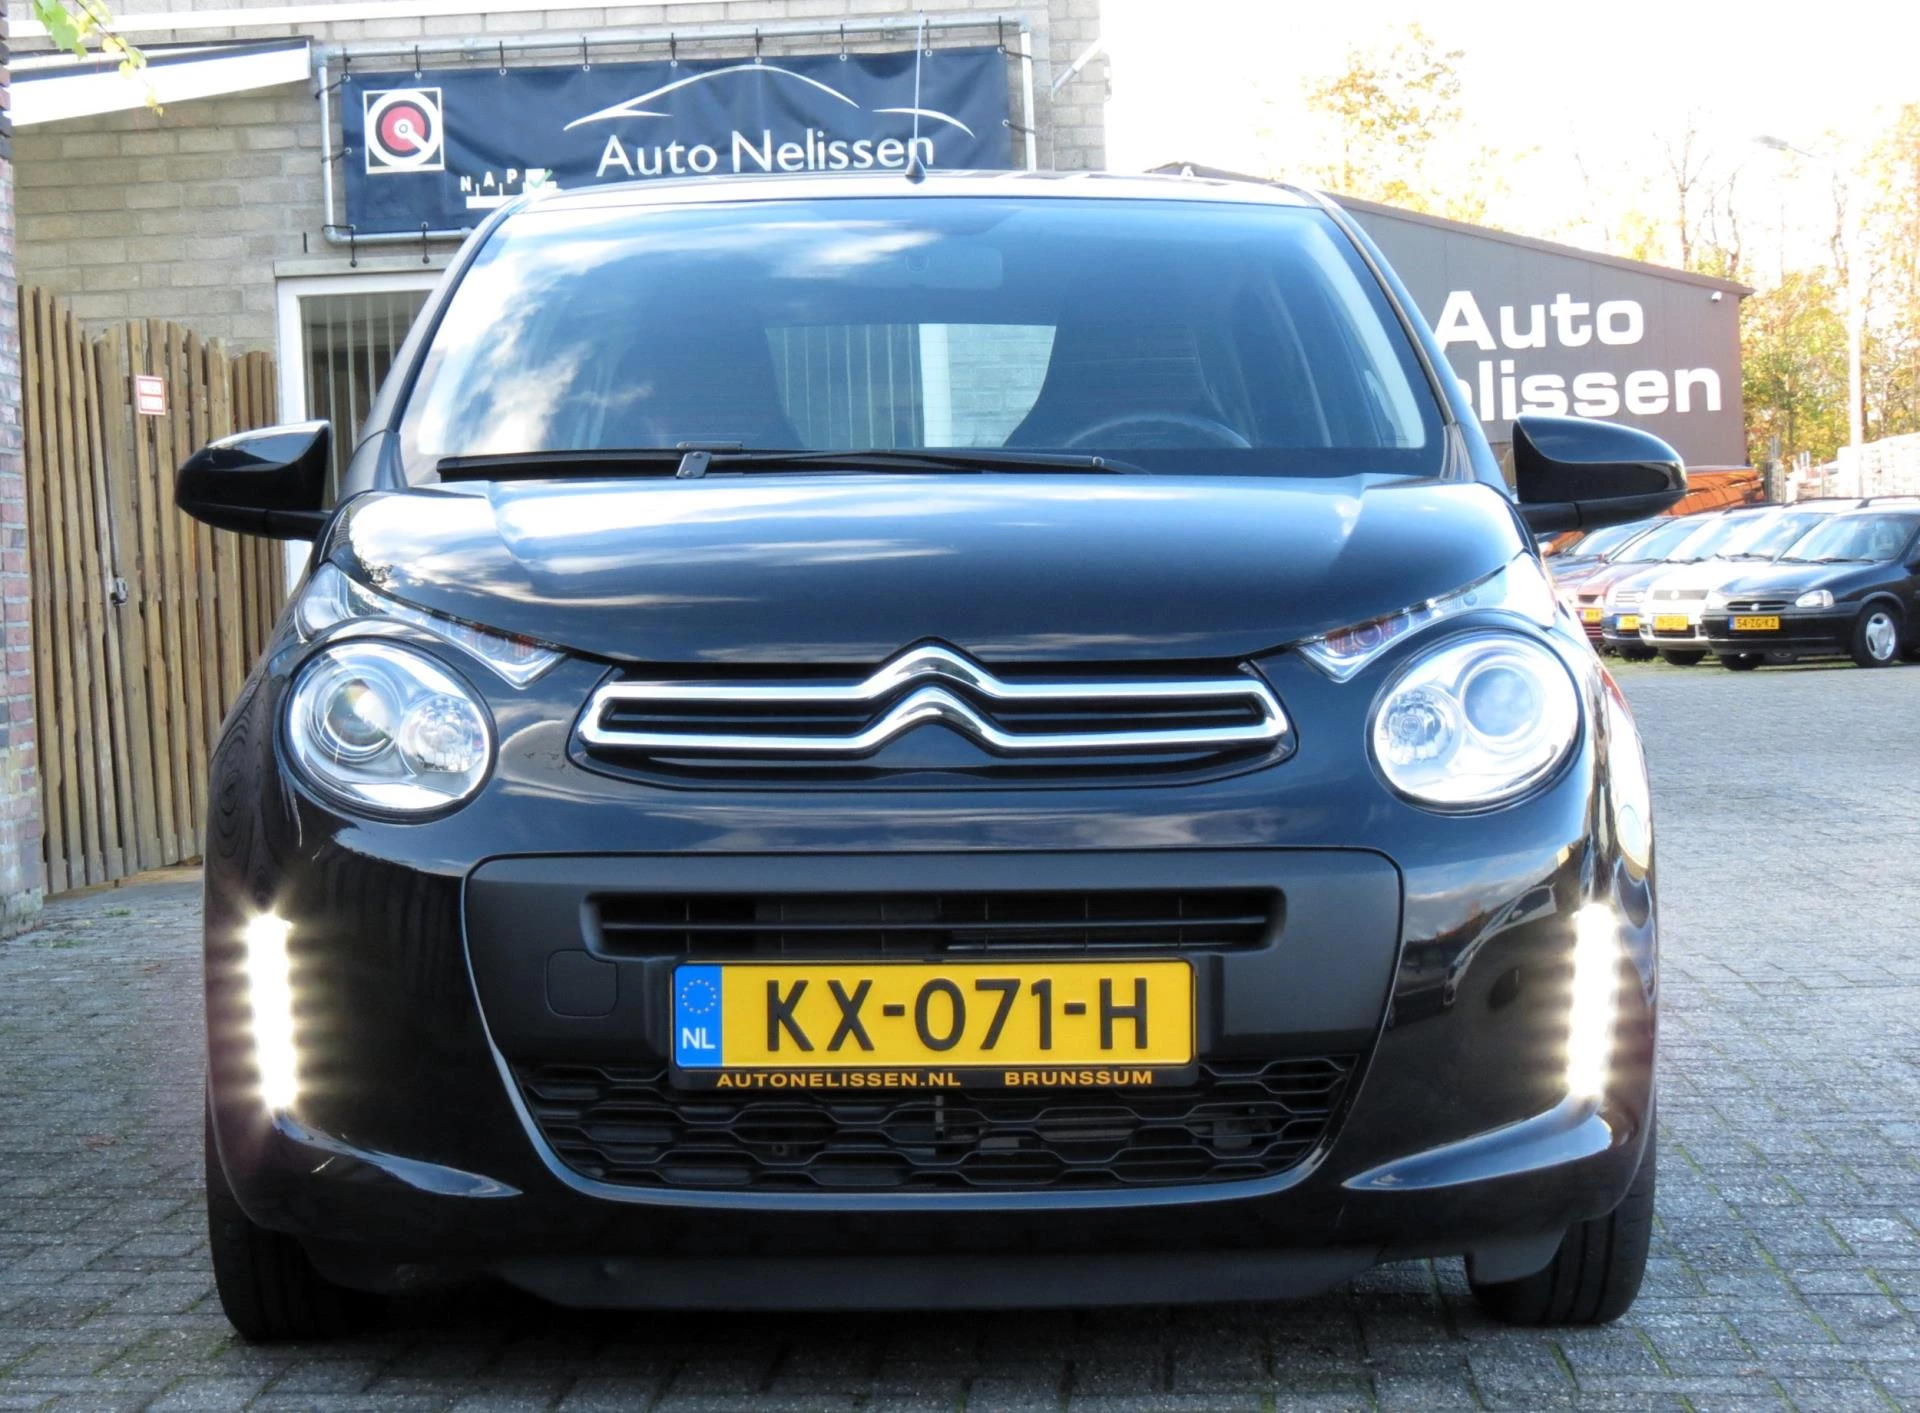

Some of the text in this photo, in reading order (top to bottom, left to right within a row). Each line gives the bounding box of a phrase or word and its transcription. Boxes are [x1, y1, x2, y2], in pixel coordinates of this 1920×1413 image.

[596, 128, 934, 177] Auto Nelissen
[1434, 290, 1644, 351] Auto
[1457, 359, 1722, 422] lissen
[682, 1027, 716, 1050] NL
[766, 977, 1148, 1052] KX-071-H
[716, 1070, 1153, 1088] AUTONELISSEN.NL BRUNSSUM
